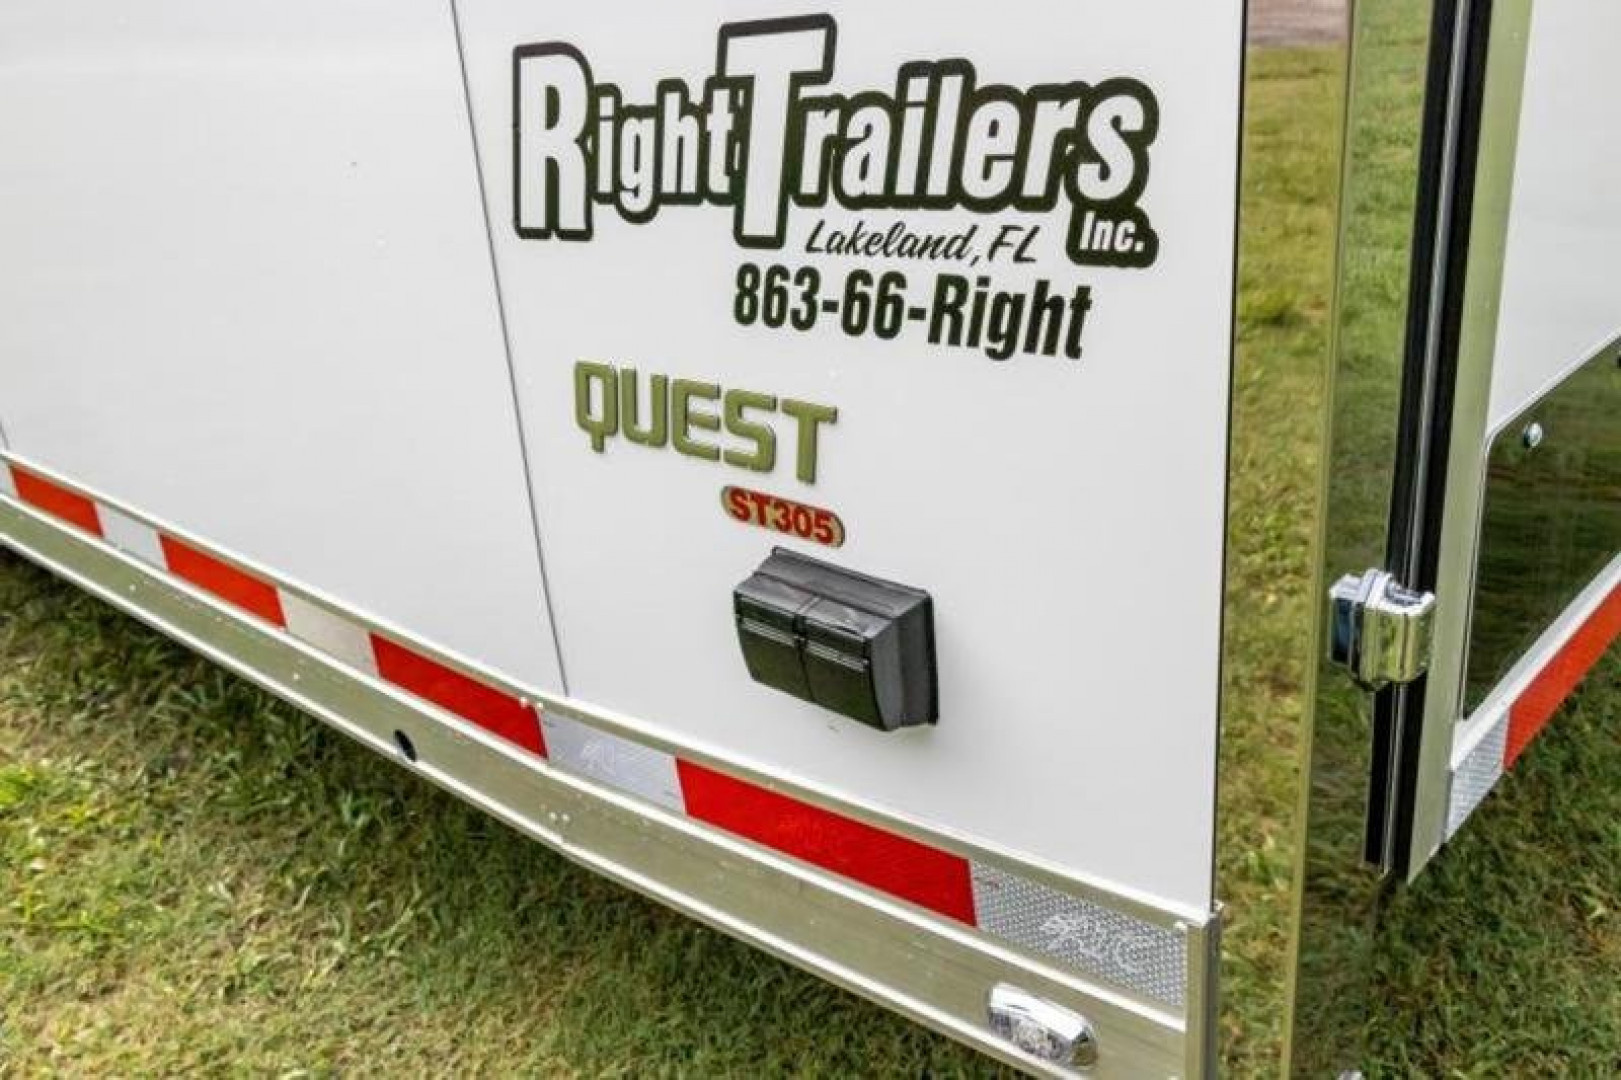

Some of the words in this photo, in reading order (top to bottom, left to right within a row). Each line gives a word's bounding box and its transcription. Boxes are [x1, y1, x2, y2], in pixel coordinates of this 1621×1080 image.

[515, 44, 738, 239] Right
[718, 15, 1155, 247] Trailers
[806, 220, 981, 265] Lakeland,
[987, 225, 1039, 263] FL
[1075, 209, 1150, 258] Inc.
[733, 263, 1092, 361] 863-66-Right
[574, 361, 838, 485] QUEST
[725, 487, 835, 546] ST305
